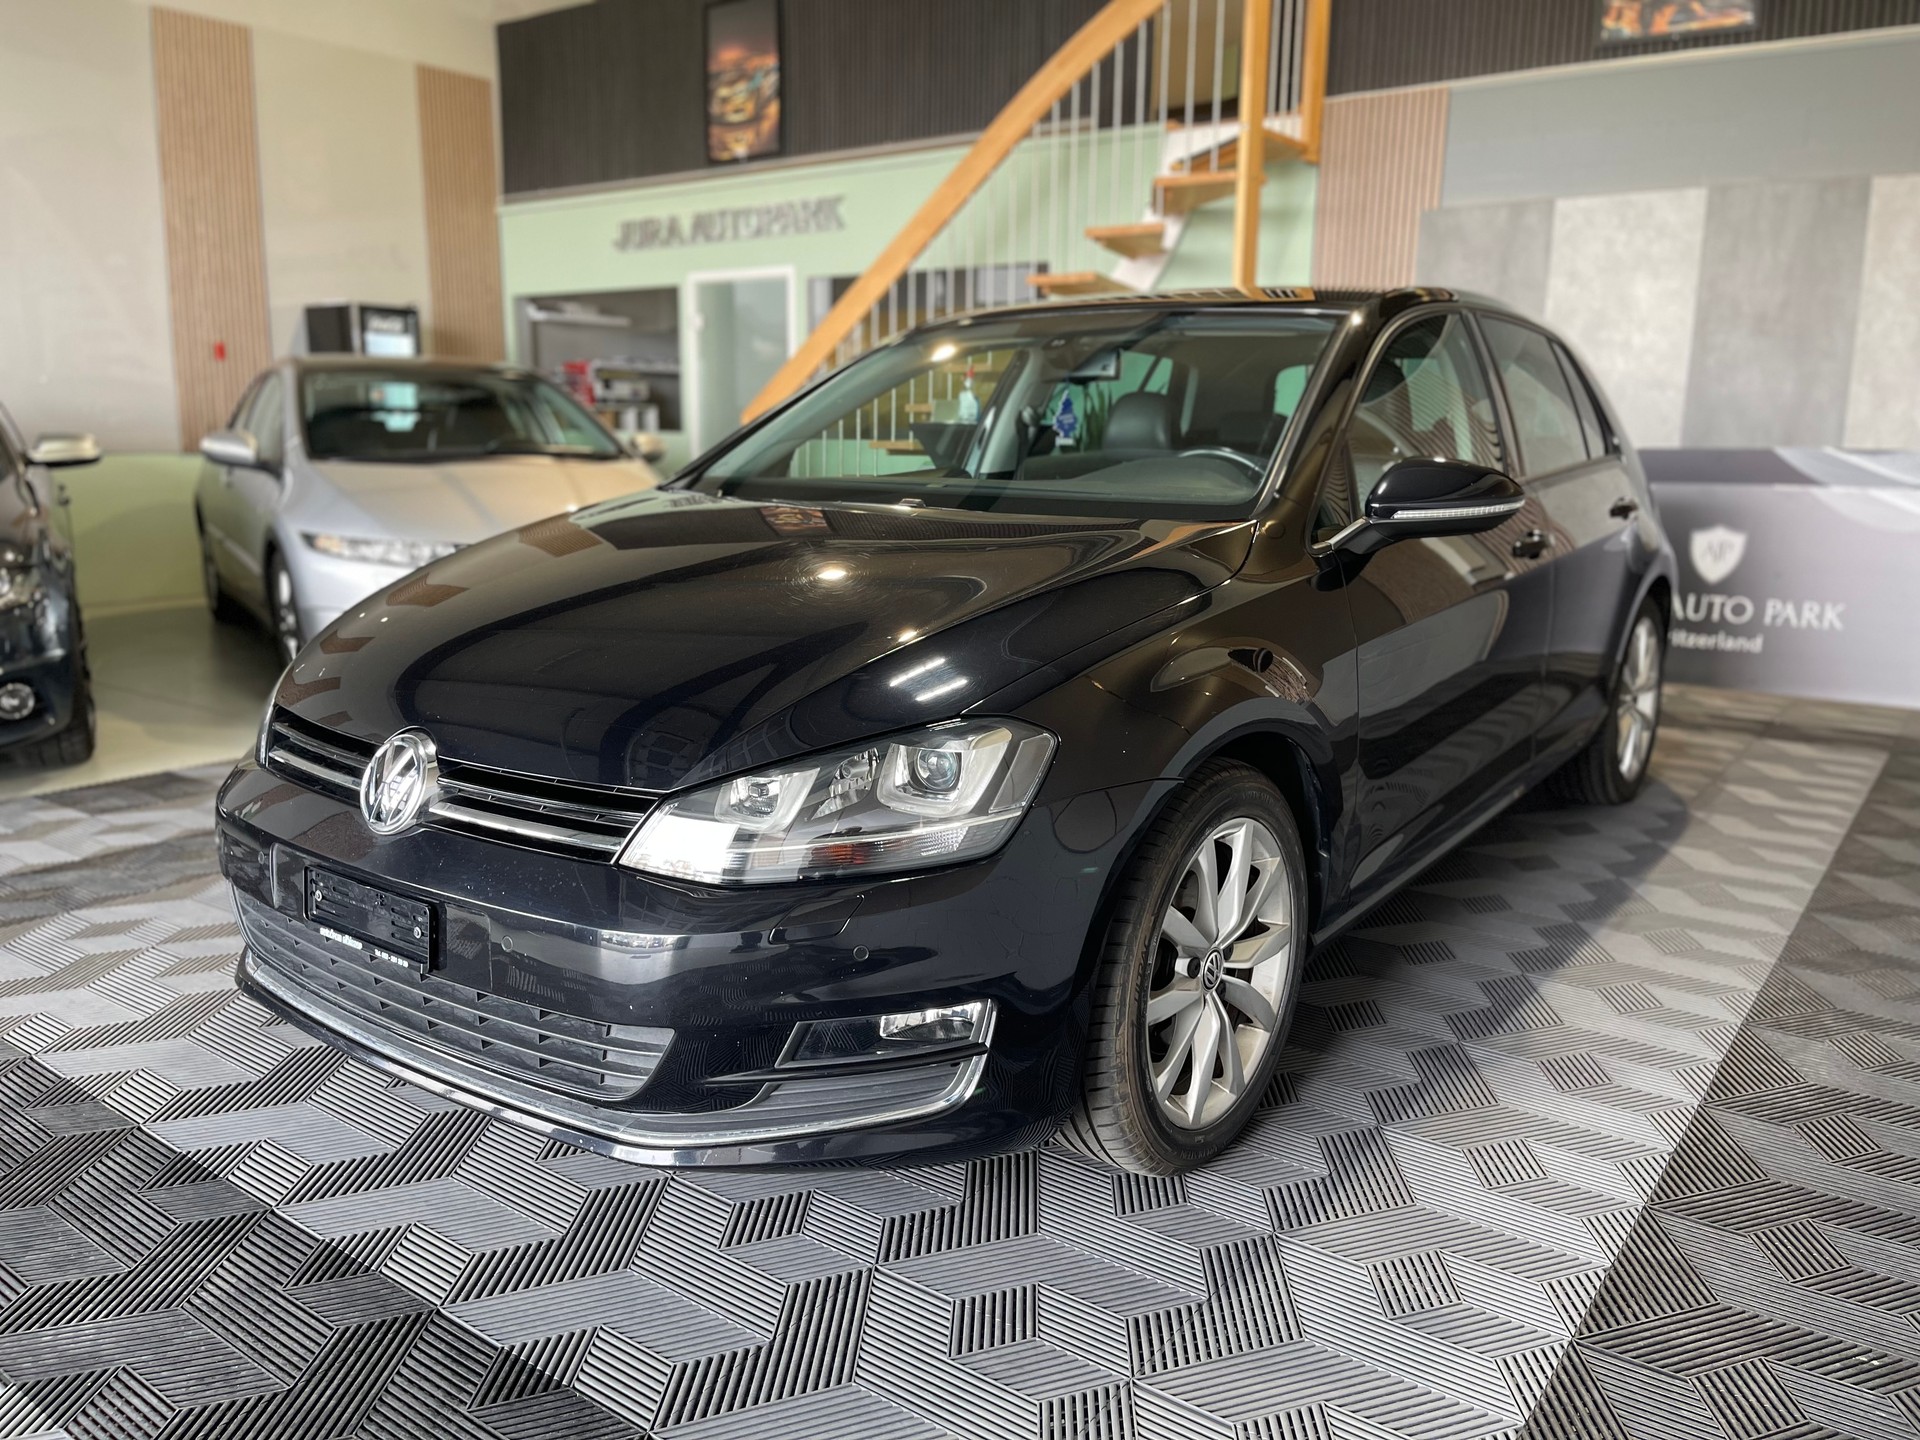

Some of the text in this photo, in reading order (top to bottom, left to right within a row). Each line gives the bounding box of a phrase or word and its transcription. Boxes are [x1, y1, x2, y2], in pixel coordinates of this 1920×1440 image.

[614, 196, 844, 251] JURA AUTOPARK
[1764, 598, 1846, 631] PARK
